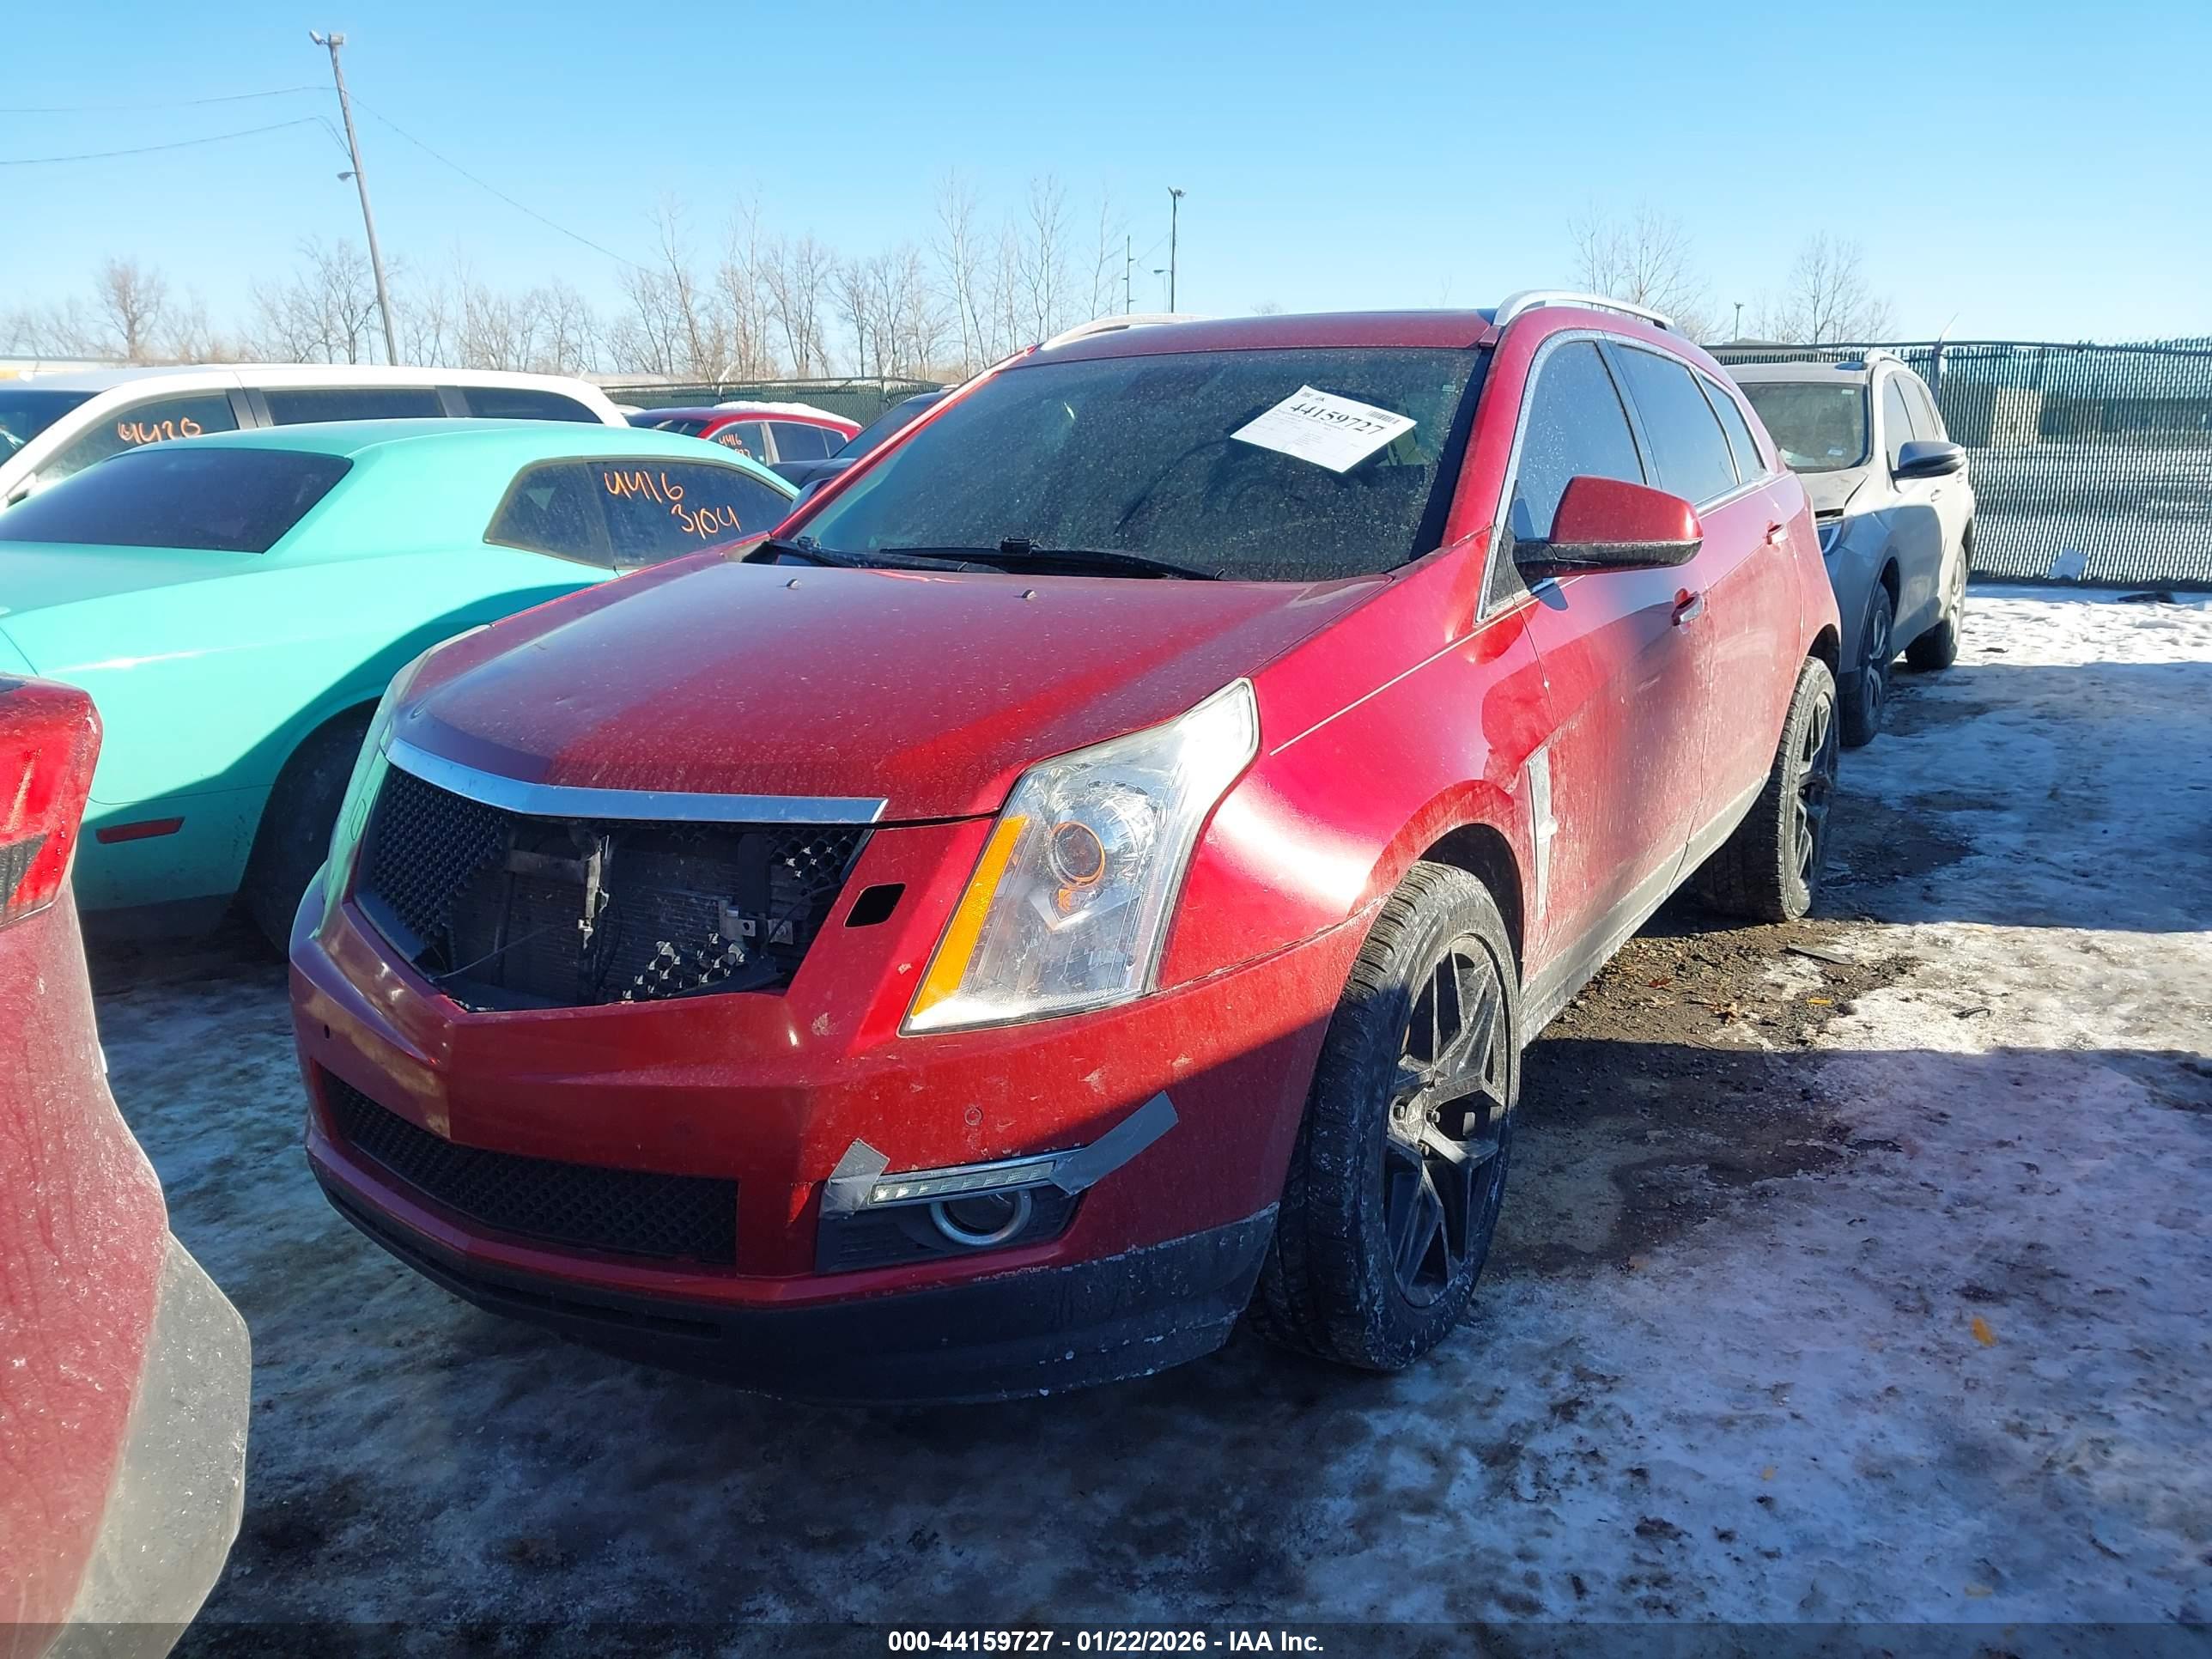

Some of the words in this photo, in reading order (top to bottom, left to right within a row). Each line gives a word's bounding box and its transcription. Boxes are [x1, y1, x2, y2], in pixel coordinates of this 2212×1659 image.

[1290, 403, 1387, 435] 44159727
[718, 433, 743, 447] 4416
[604, 471, 684, 503] 4416
[671, 503, 741, 540] 3104
